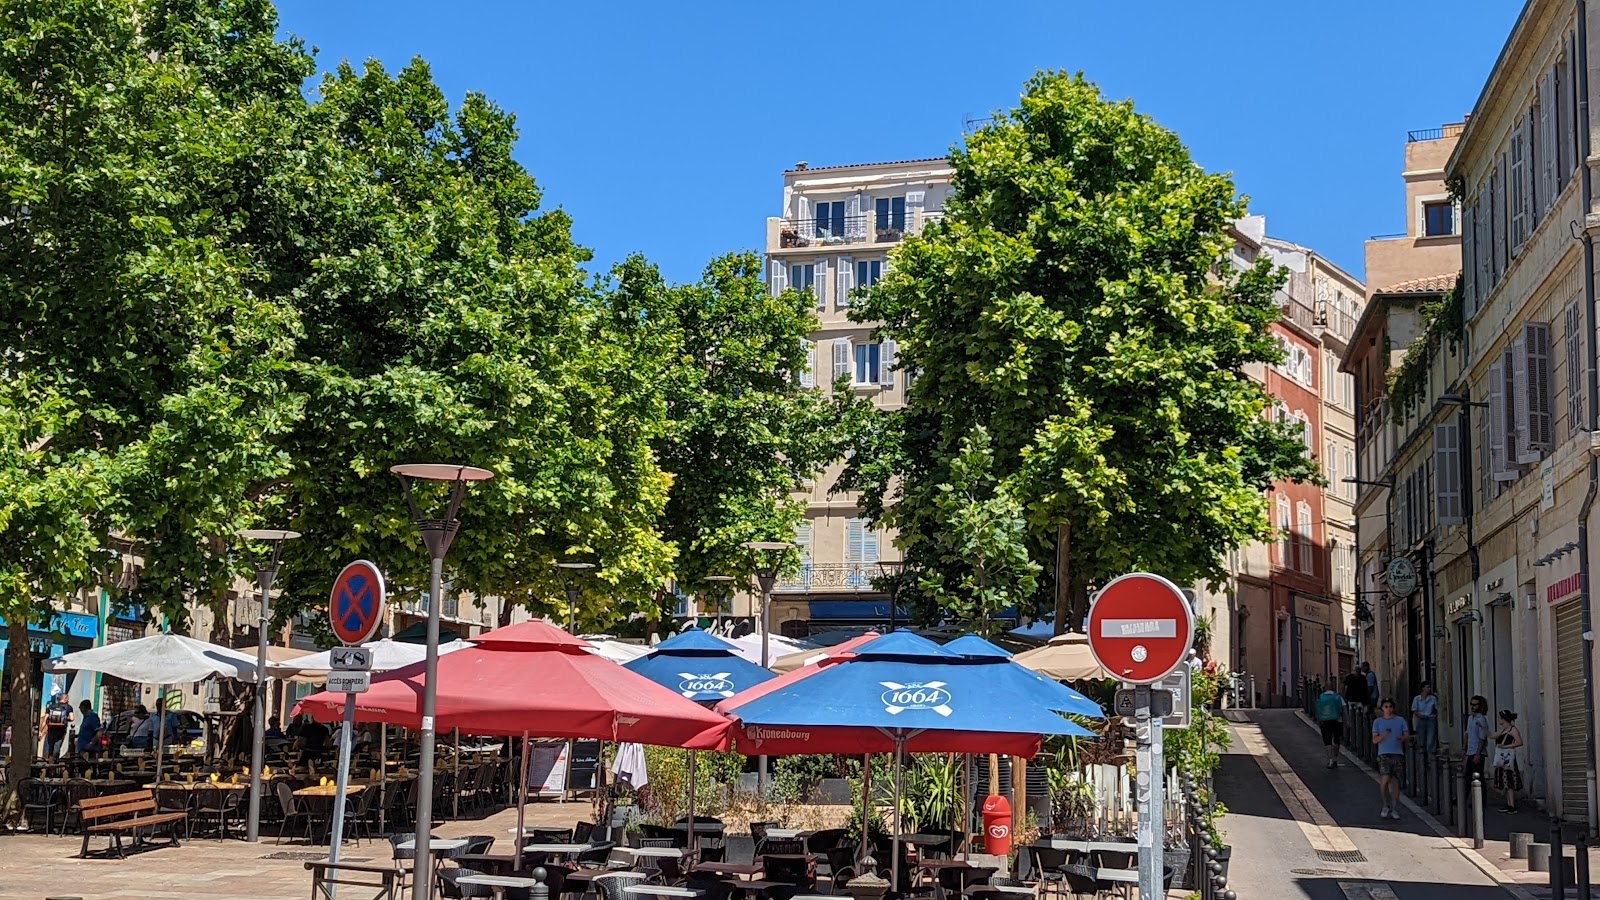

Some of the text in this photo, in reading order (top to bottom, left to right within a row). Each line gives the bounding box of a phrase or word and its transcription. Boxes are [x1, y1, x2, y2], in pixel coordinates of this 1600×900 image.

[687, 681, 725, 690] 1664
[891, 688, 940, 703] 1664
[756, 726, 810, 741] Kronenbourg
